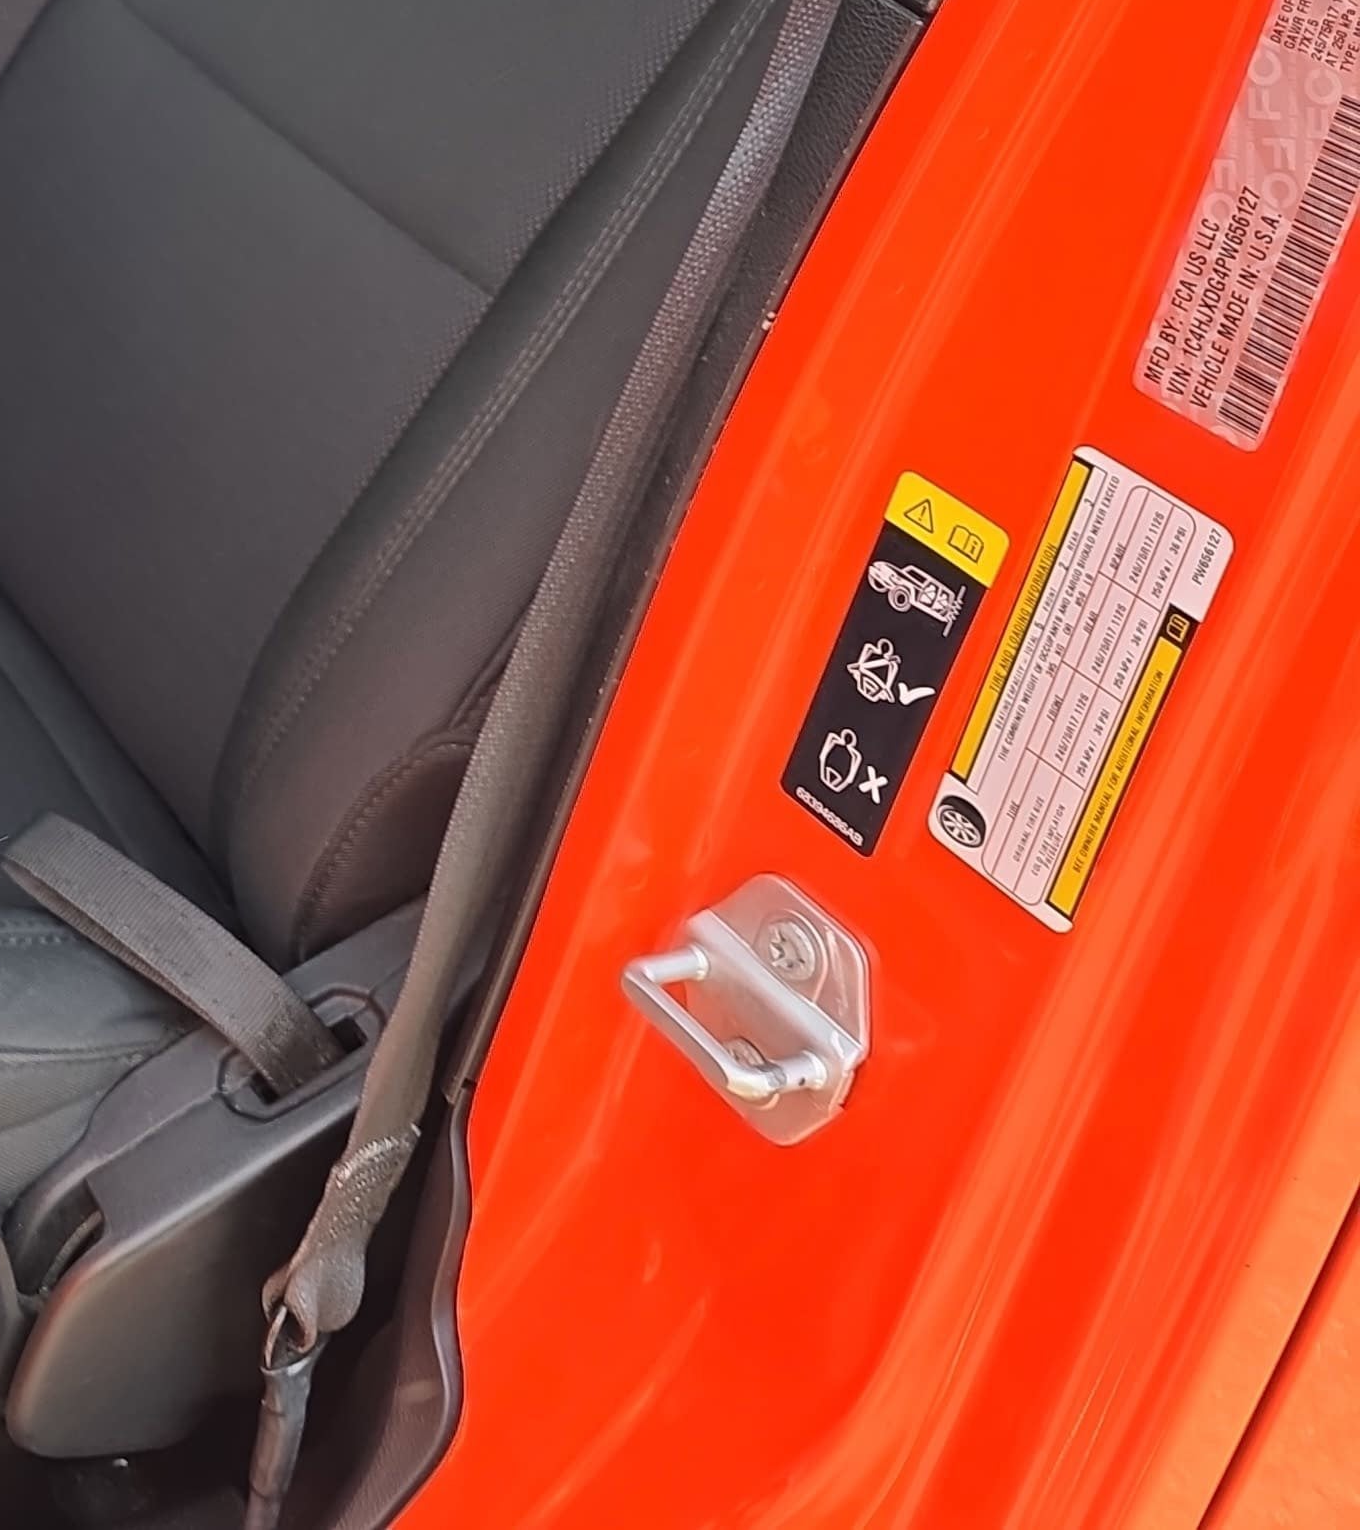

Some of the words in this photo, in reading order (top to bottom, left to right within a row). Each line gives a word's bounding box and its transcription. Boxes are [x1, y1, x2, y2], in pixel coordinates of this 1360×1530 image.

[1269, 14, 1289, 44] DATE
[1283, 16, 1305, 50] GAWR
[1310, 6, 1339, 61] 245/75R17
[1324, 51, 1339, 67] AT
[1194, 218, 1220, 250] LLC
[1247, 214, 1282, 261] U.S.A.
[1183, 251, 1207, 277] US
[1236, 264, 1261, 290] IN:
[1166, 363, 1193, 396] VIN:
[1181, 186, 1260, 358] 1C4HJXDG4PW656127
[1170, 279, 1197, 312] FCA
[1159, 316, 1183, 345] BY:
[1217, 290, 1249, 341] MADE
[1143, 346, 1170, 384] MFD
[1189, 341, 1230, 408] VEHICLE
[1191, 528, 1222, 585] PW656127
